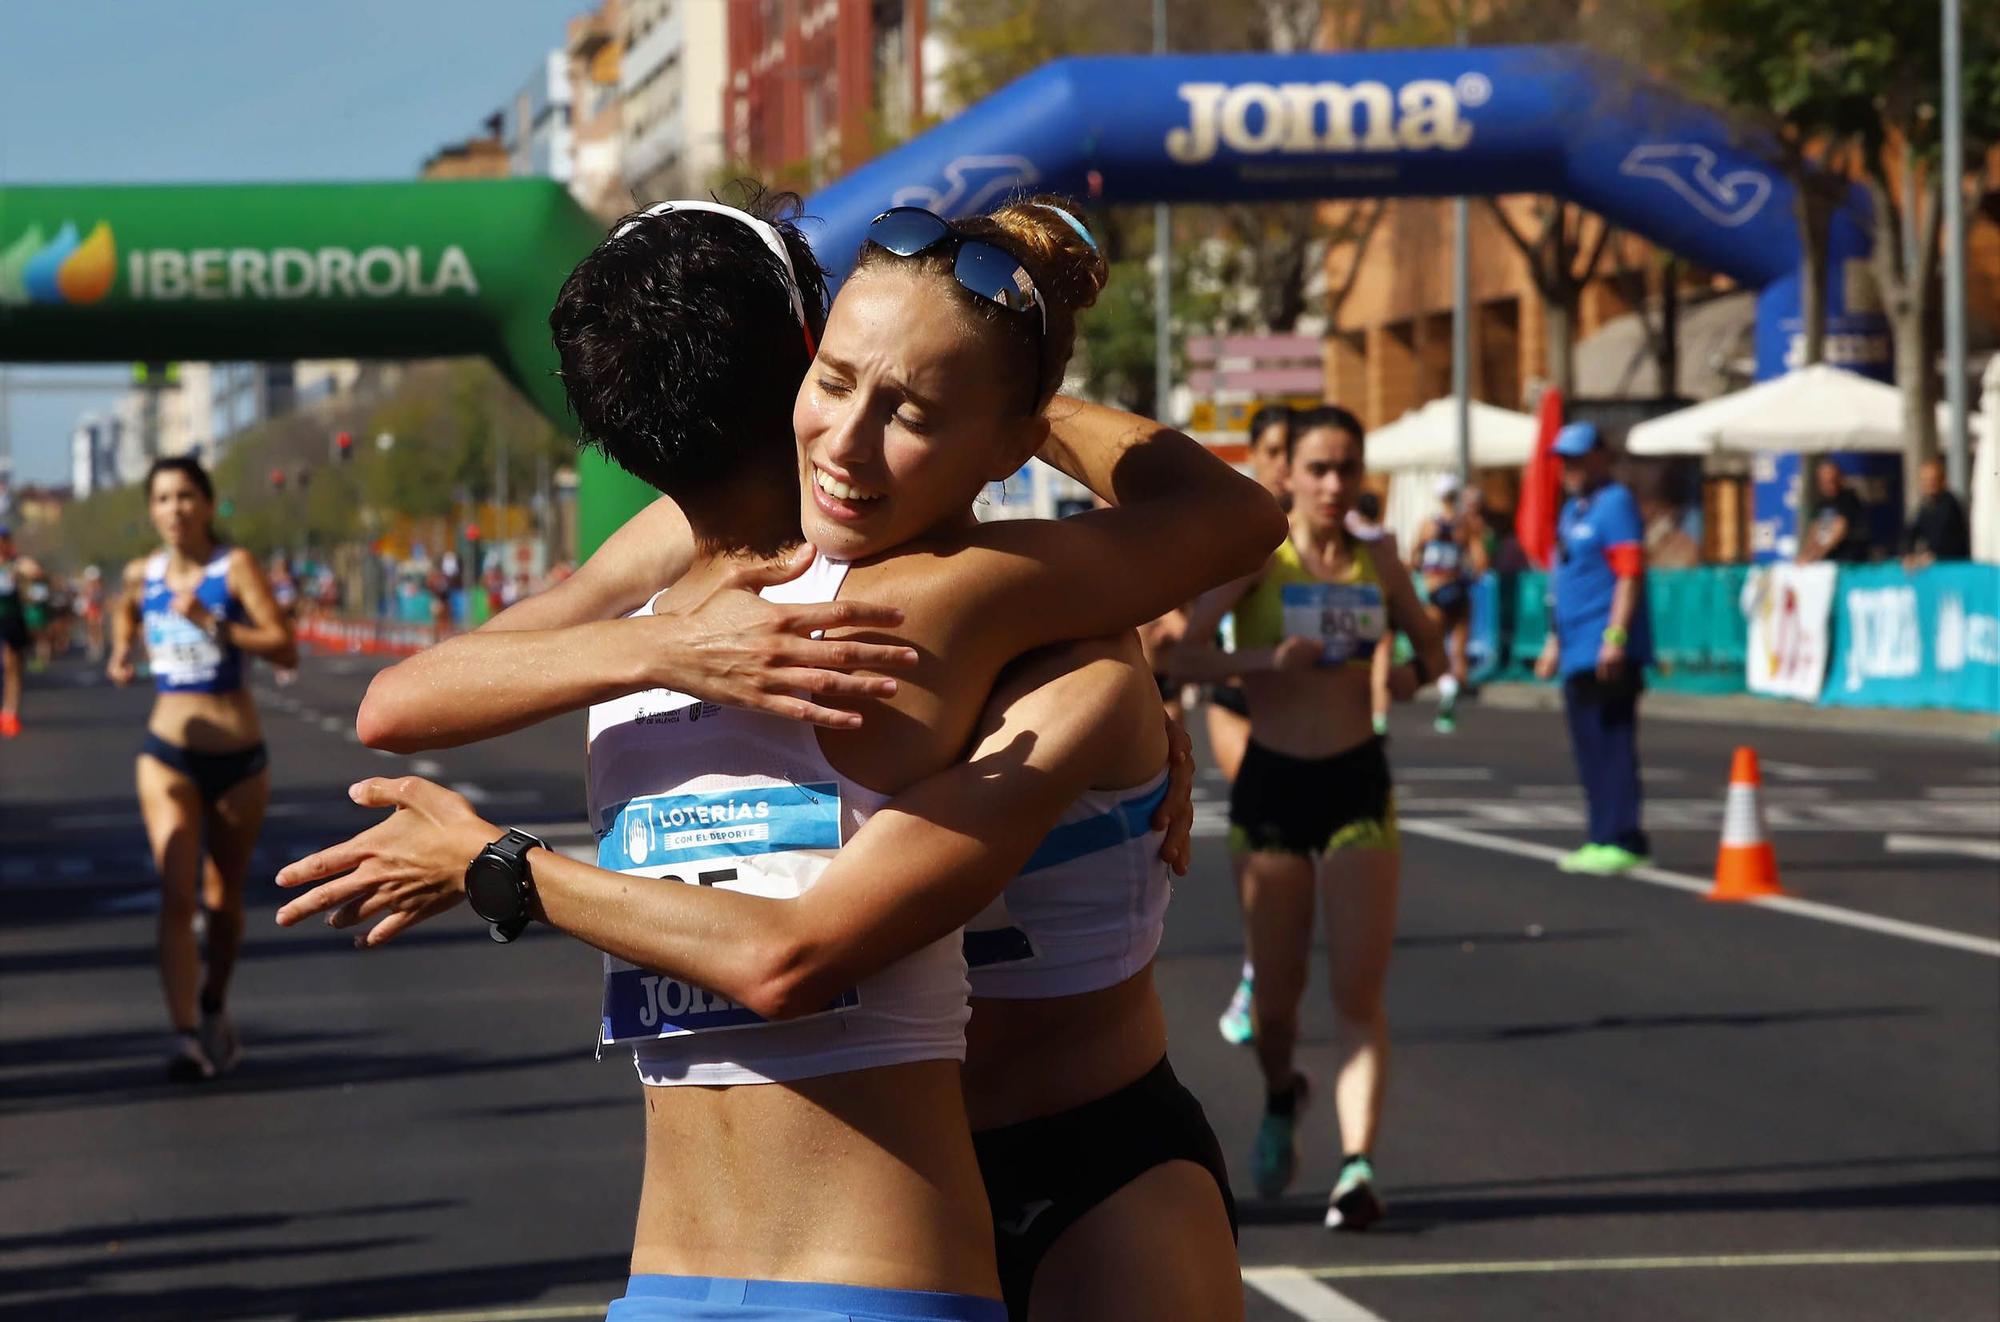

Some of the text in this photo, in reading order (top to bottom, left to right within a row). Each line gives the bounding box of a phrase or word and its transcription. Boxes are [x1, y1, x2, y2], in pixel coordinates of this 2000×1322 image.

[128, 245, 480, 300] IBERDROLA
[659, 799, 769, 829] LOTERÍAS
[674, 828, 755, 845] CON EL DEPORTE
